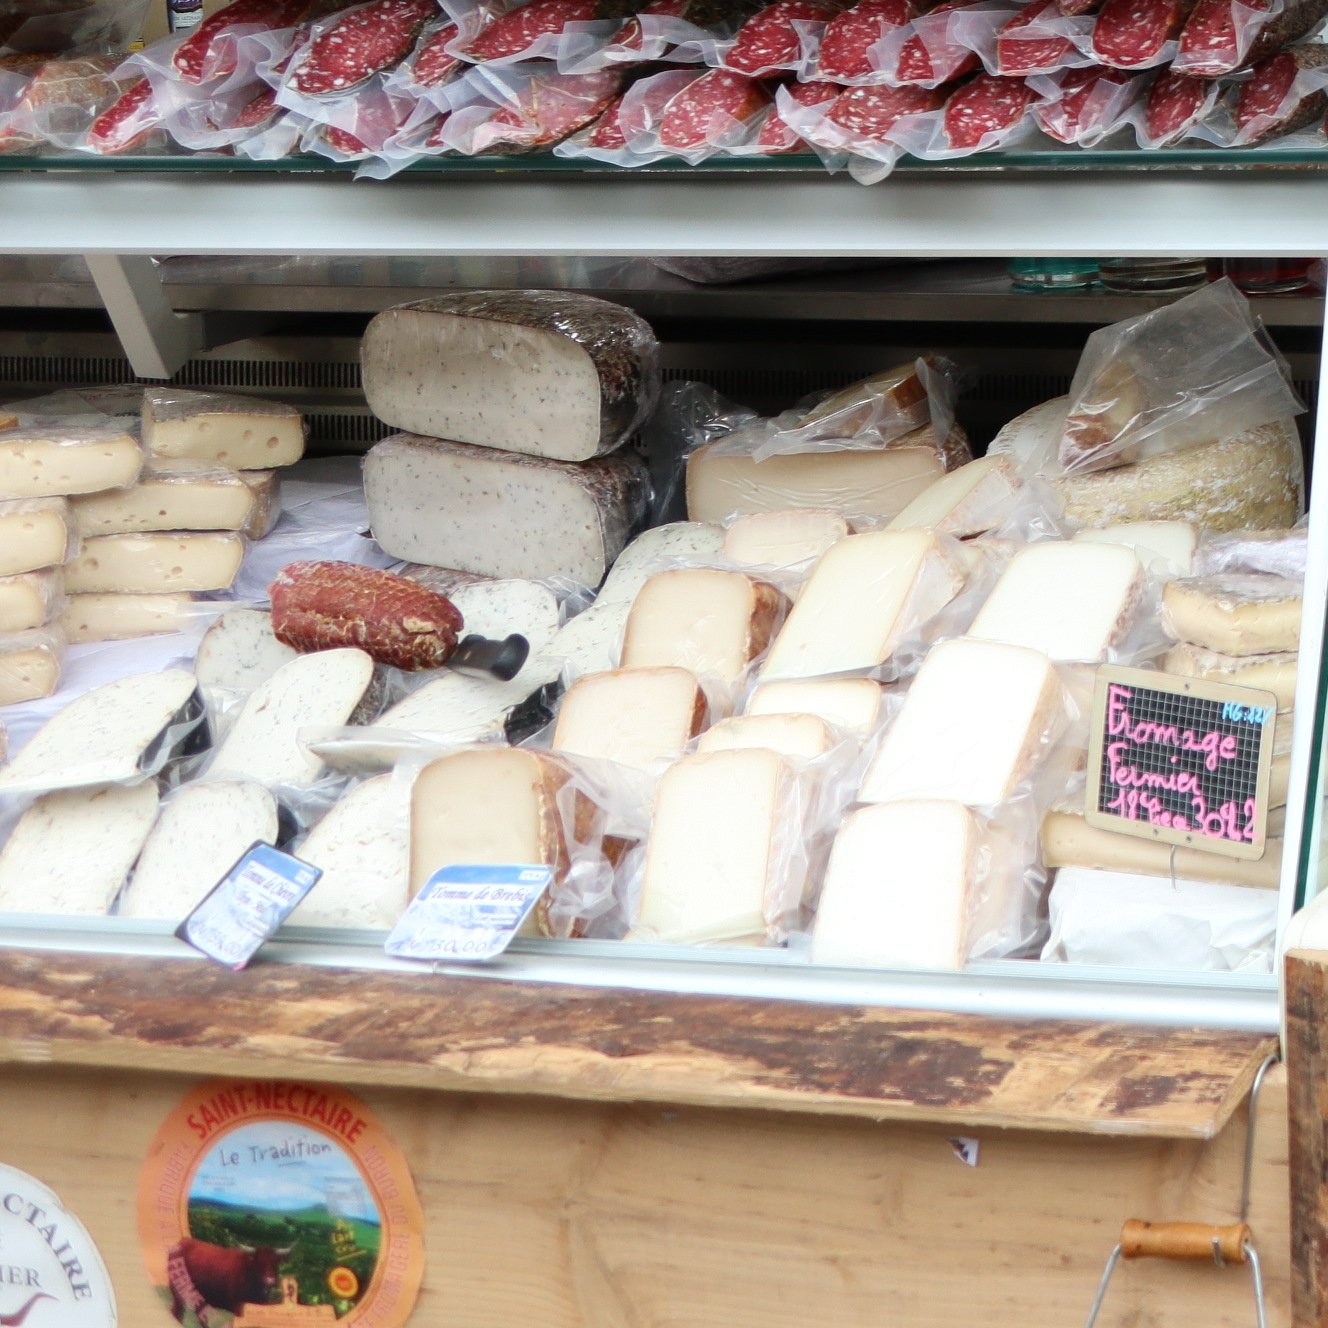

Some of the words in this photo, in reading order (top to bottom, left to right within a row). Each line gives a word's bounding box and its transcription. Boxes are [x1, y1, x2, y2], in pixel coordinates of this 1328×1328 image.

[1108, 684, 1237, 772] Fromage
[1107, 739, 1204, 795] Fermier
[491, 887, 532, 902] Brebis
[187, 1082, 368, 1143] SAINT-NECTAIRE
[220, 1148, 240, 1168] Le
[248, 1134, 333, 1163] Tradition
